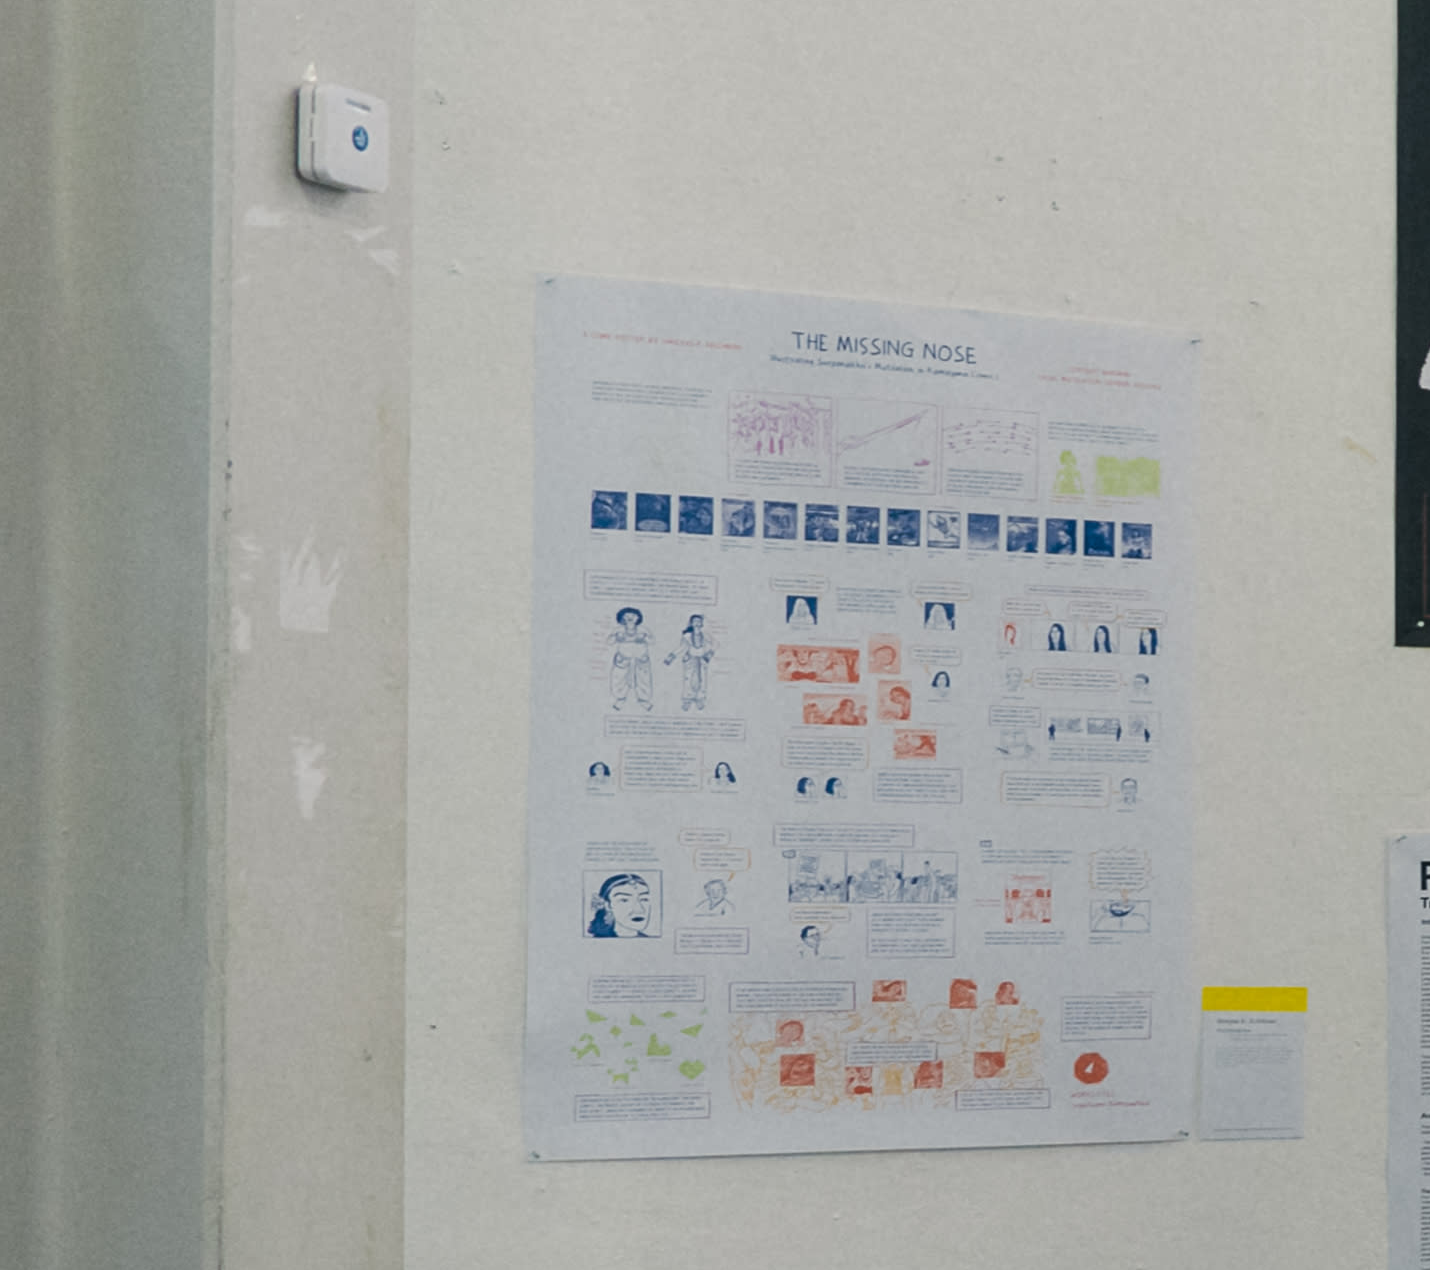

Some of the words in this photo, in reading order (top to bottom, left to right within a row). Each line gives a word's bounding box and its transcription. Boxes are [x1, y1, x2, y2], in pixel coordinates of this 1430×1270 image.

[791, 331, 828, 352] THE
[836, 335, 915, 359] MISSING
[922, 342, 977, 365] NOSE
